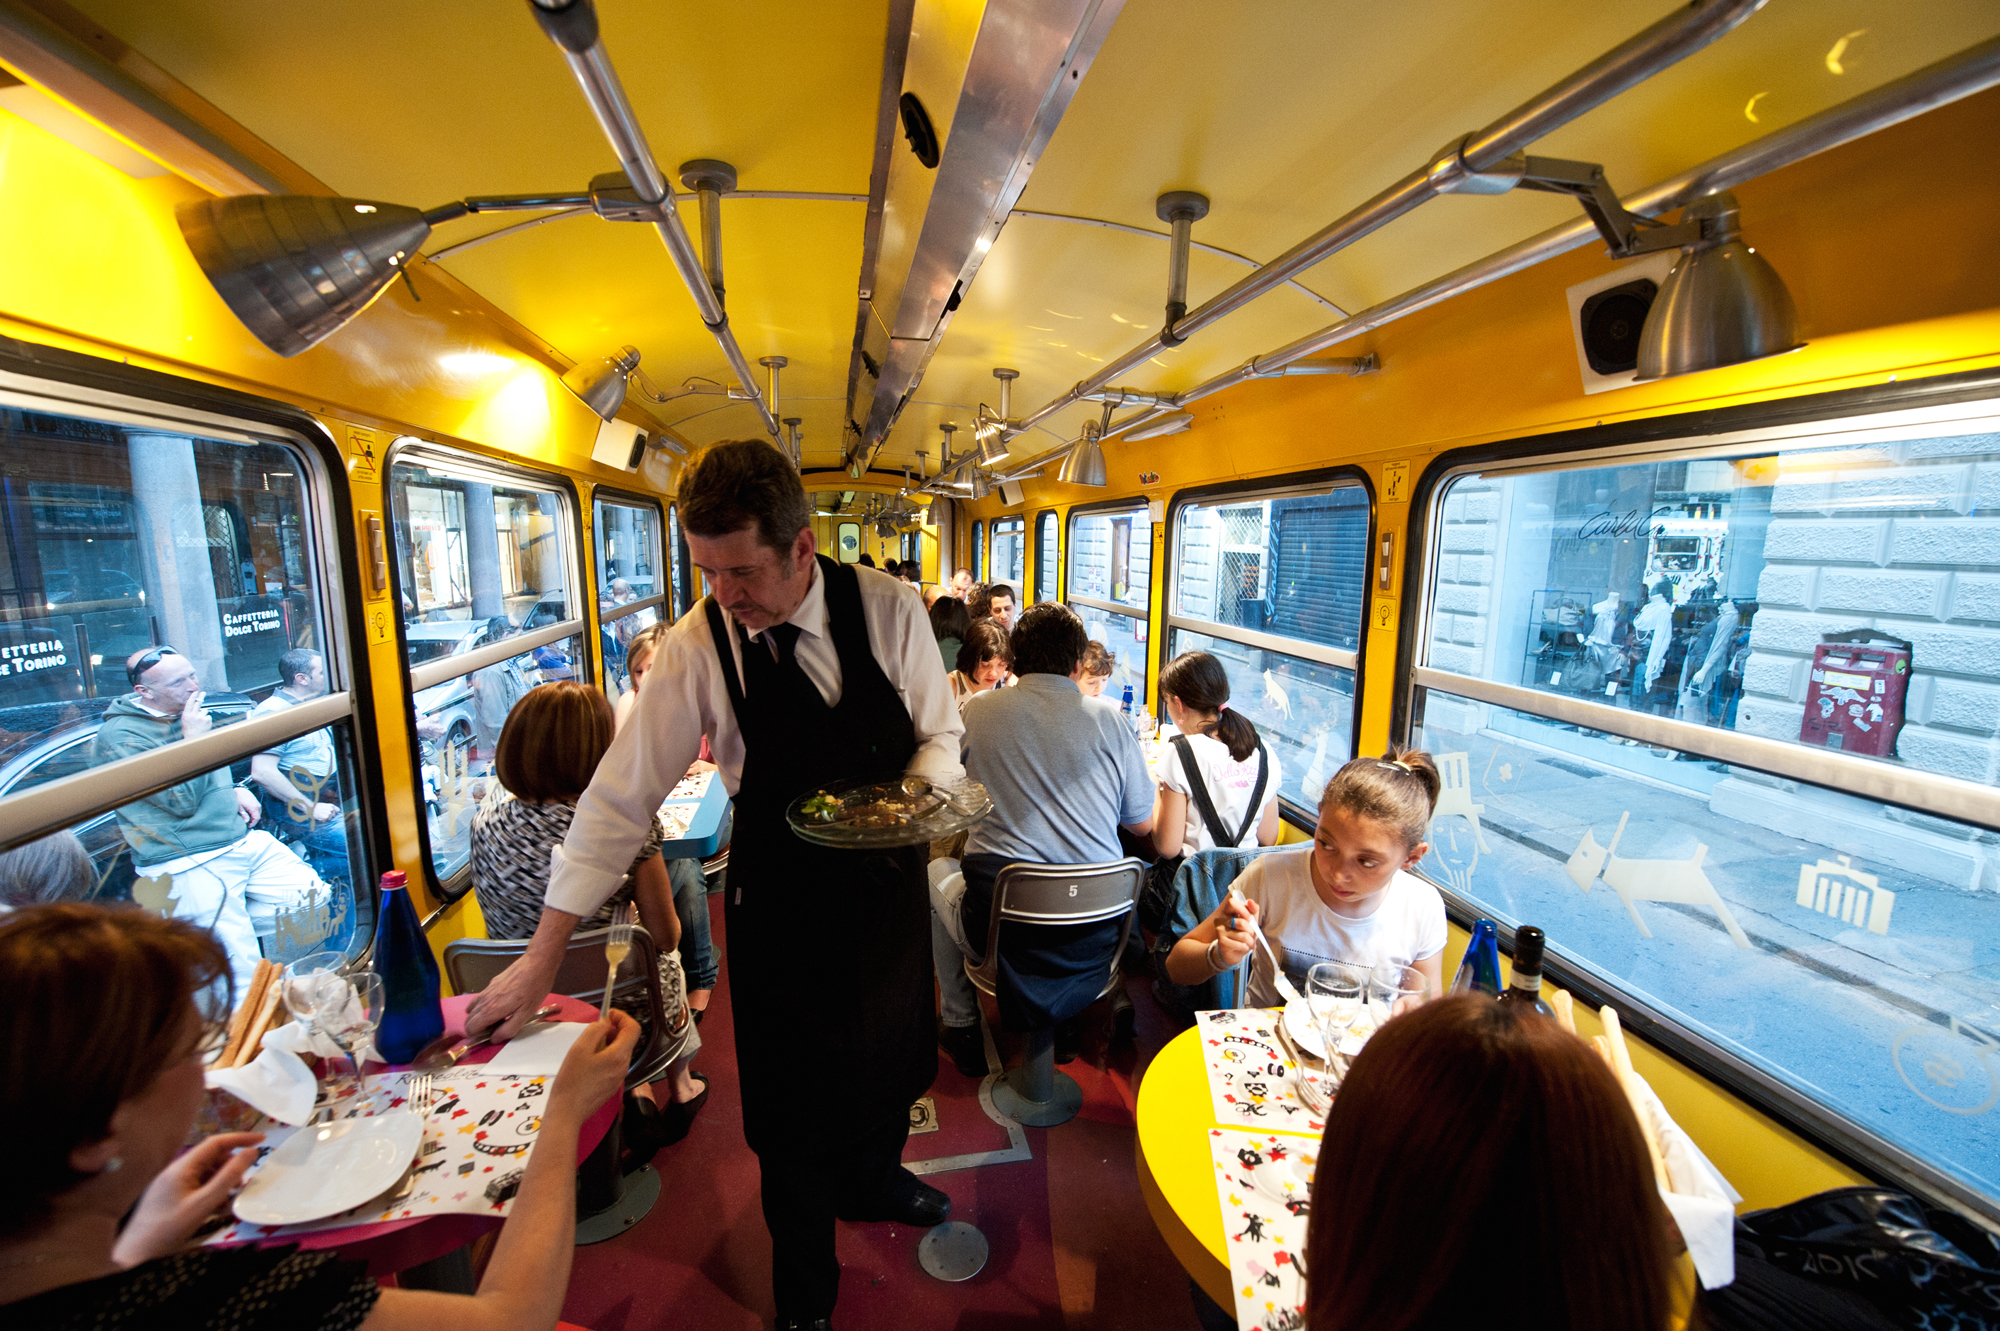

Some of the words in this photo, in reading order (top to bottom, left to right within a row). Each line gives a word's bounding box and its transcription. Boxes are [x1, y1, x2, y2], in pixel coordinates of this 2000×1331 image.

[223, 609, 279, 626] CAFFETTERIA
[224, 624, 253, 637] DOLCE
[252, 619, 281, 632] TORINO
[0, 663, 11, 677] E
[11, 654, 67, 673] TORINO
[1069, 884, 1078, 898] 5
